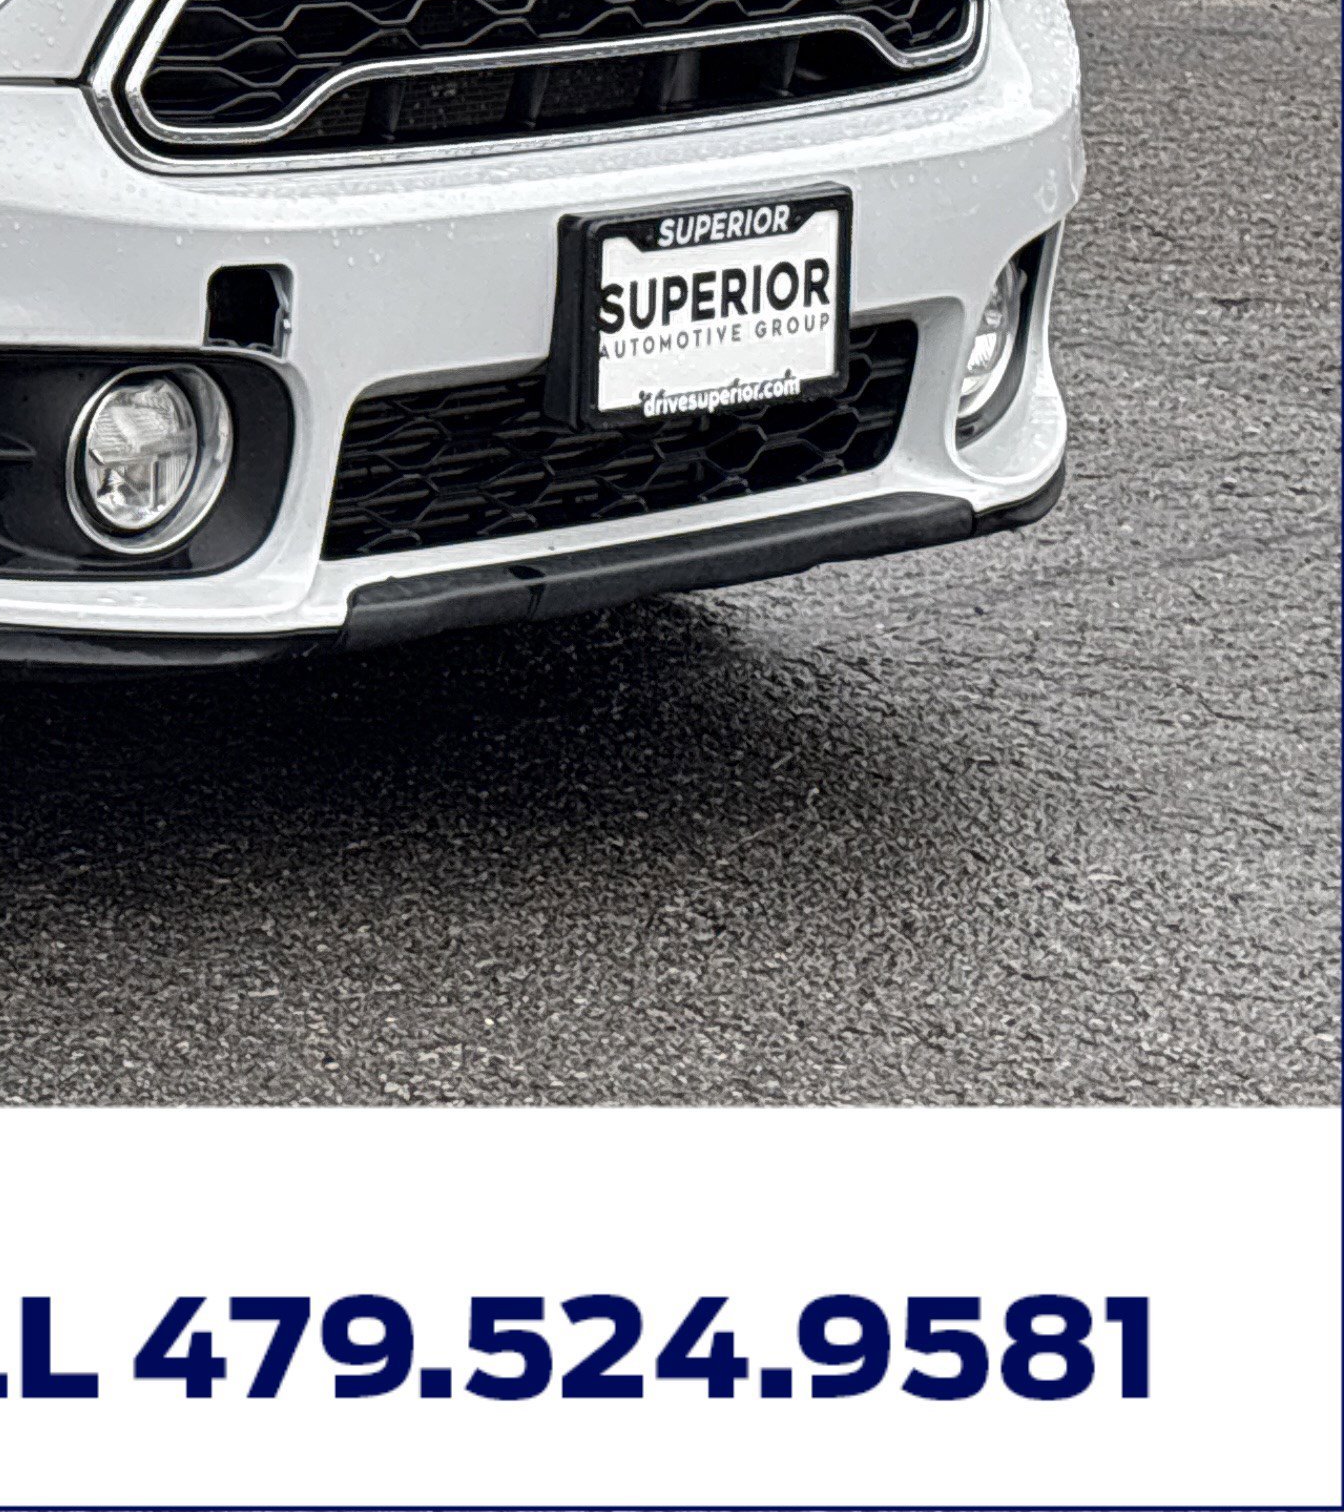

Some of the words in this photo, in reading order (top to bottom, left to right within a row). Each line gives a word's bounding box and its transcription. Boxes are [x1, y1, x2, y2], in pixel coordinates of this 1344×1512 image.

[657, 204, 791, 248] SUPERIOR
[596, 257, 831, 334] SUPERIOR
[598, 323, 743, 360] AUTOMOTIVE
[754, 312, 831, 339] GROUP
[644, 376, 801, 418] drivesuperior.com
